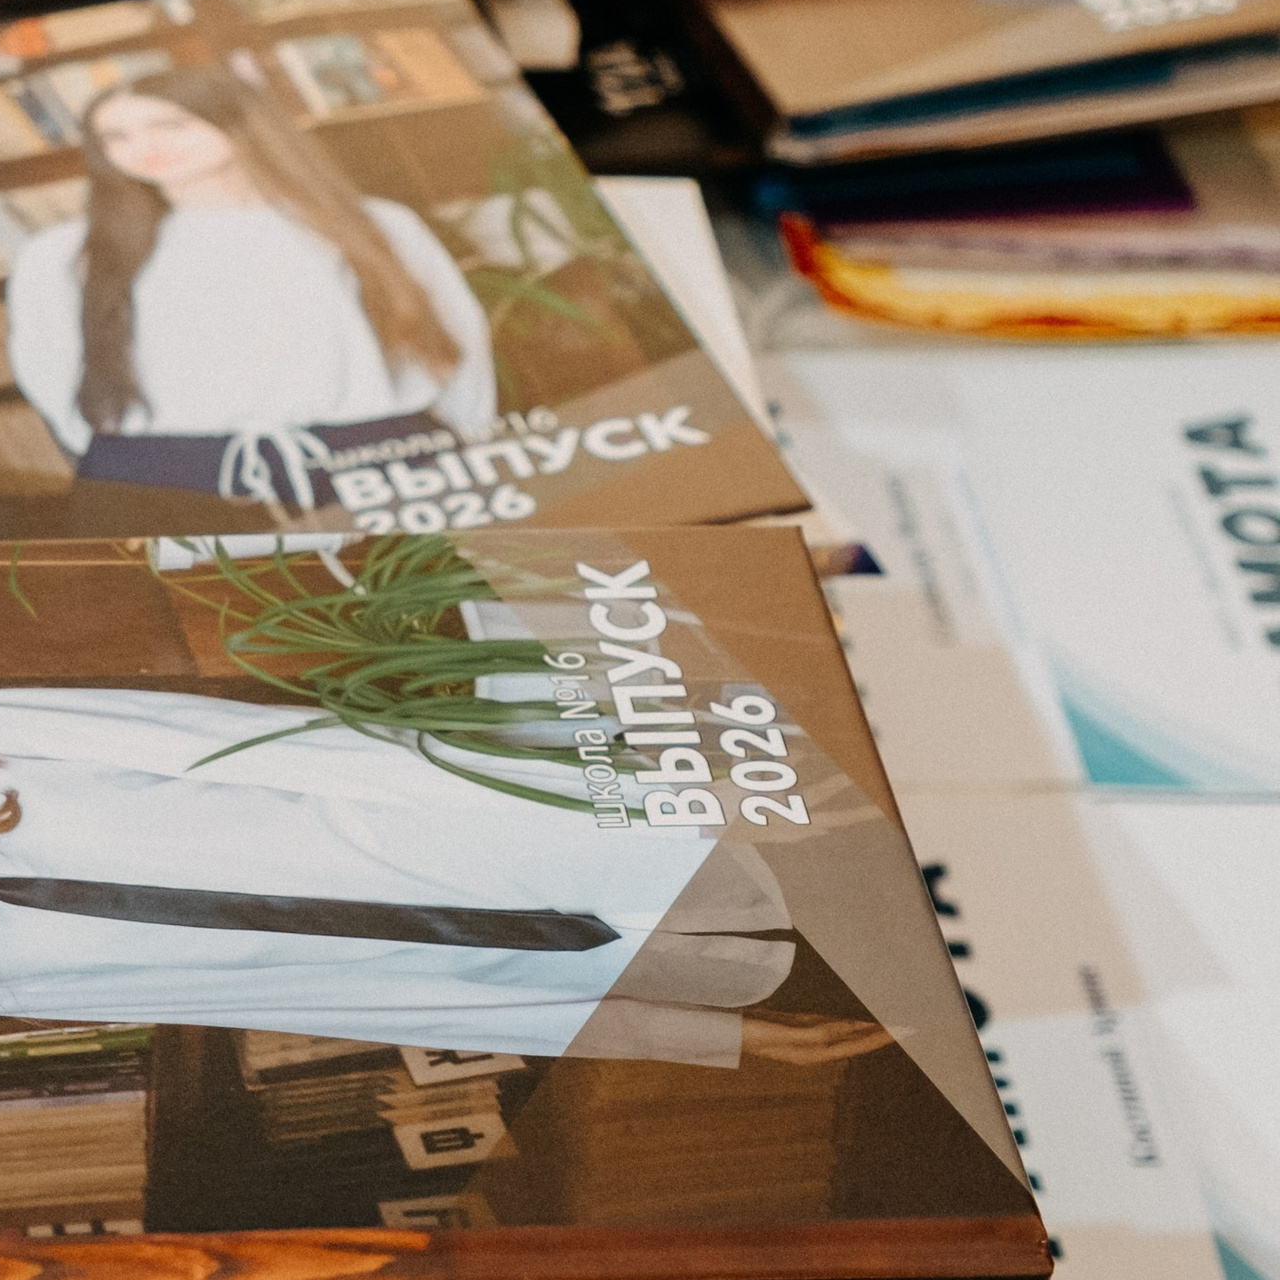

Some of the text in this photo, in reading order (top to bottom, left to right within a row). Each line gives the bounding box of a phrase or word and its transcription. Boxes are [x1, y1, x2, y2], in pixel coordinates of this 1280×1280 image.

[331, 404, 712, 511] ВЫПУСК
[353, 483, 536, 535] 2026
[543, 651, 631, 828] школа №16
[576, 559, 727, 829] ВЫПУСК
[710, 695, 810, 826] 2026
